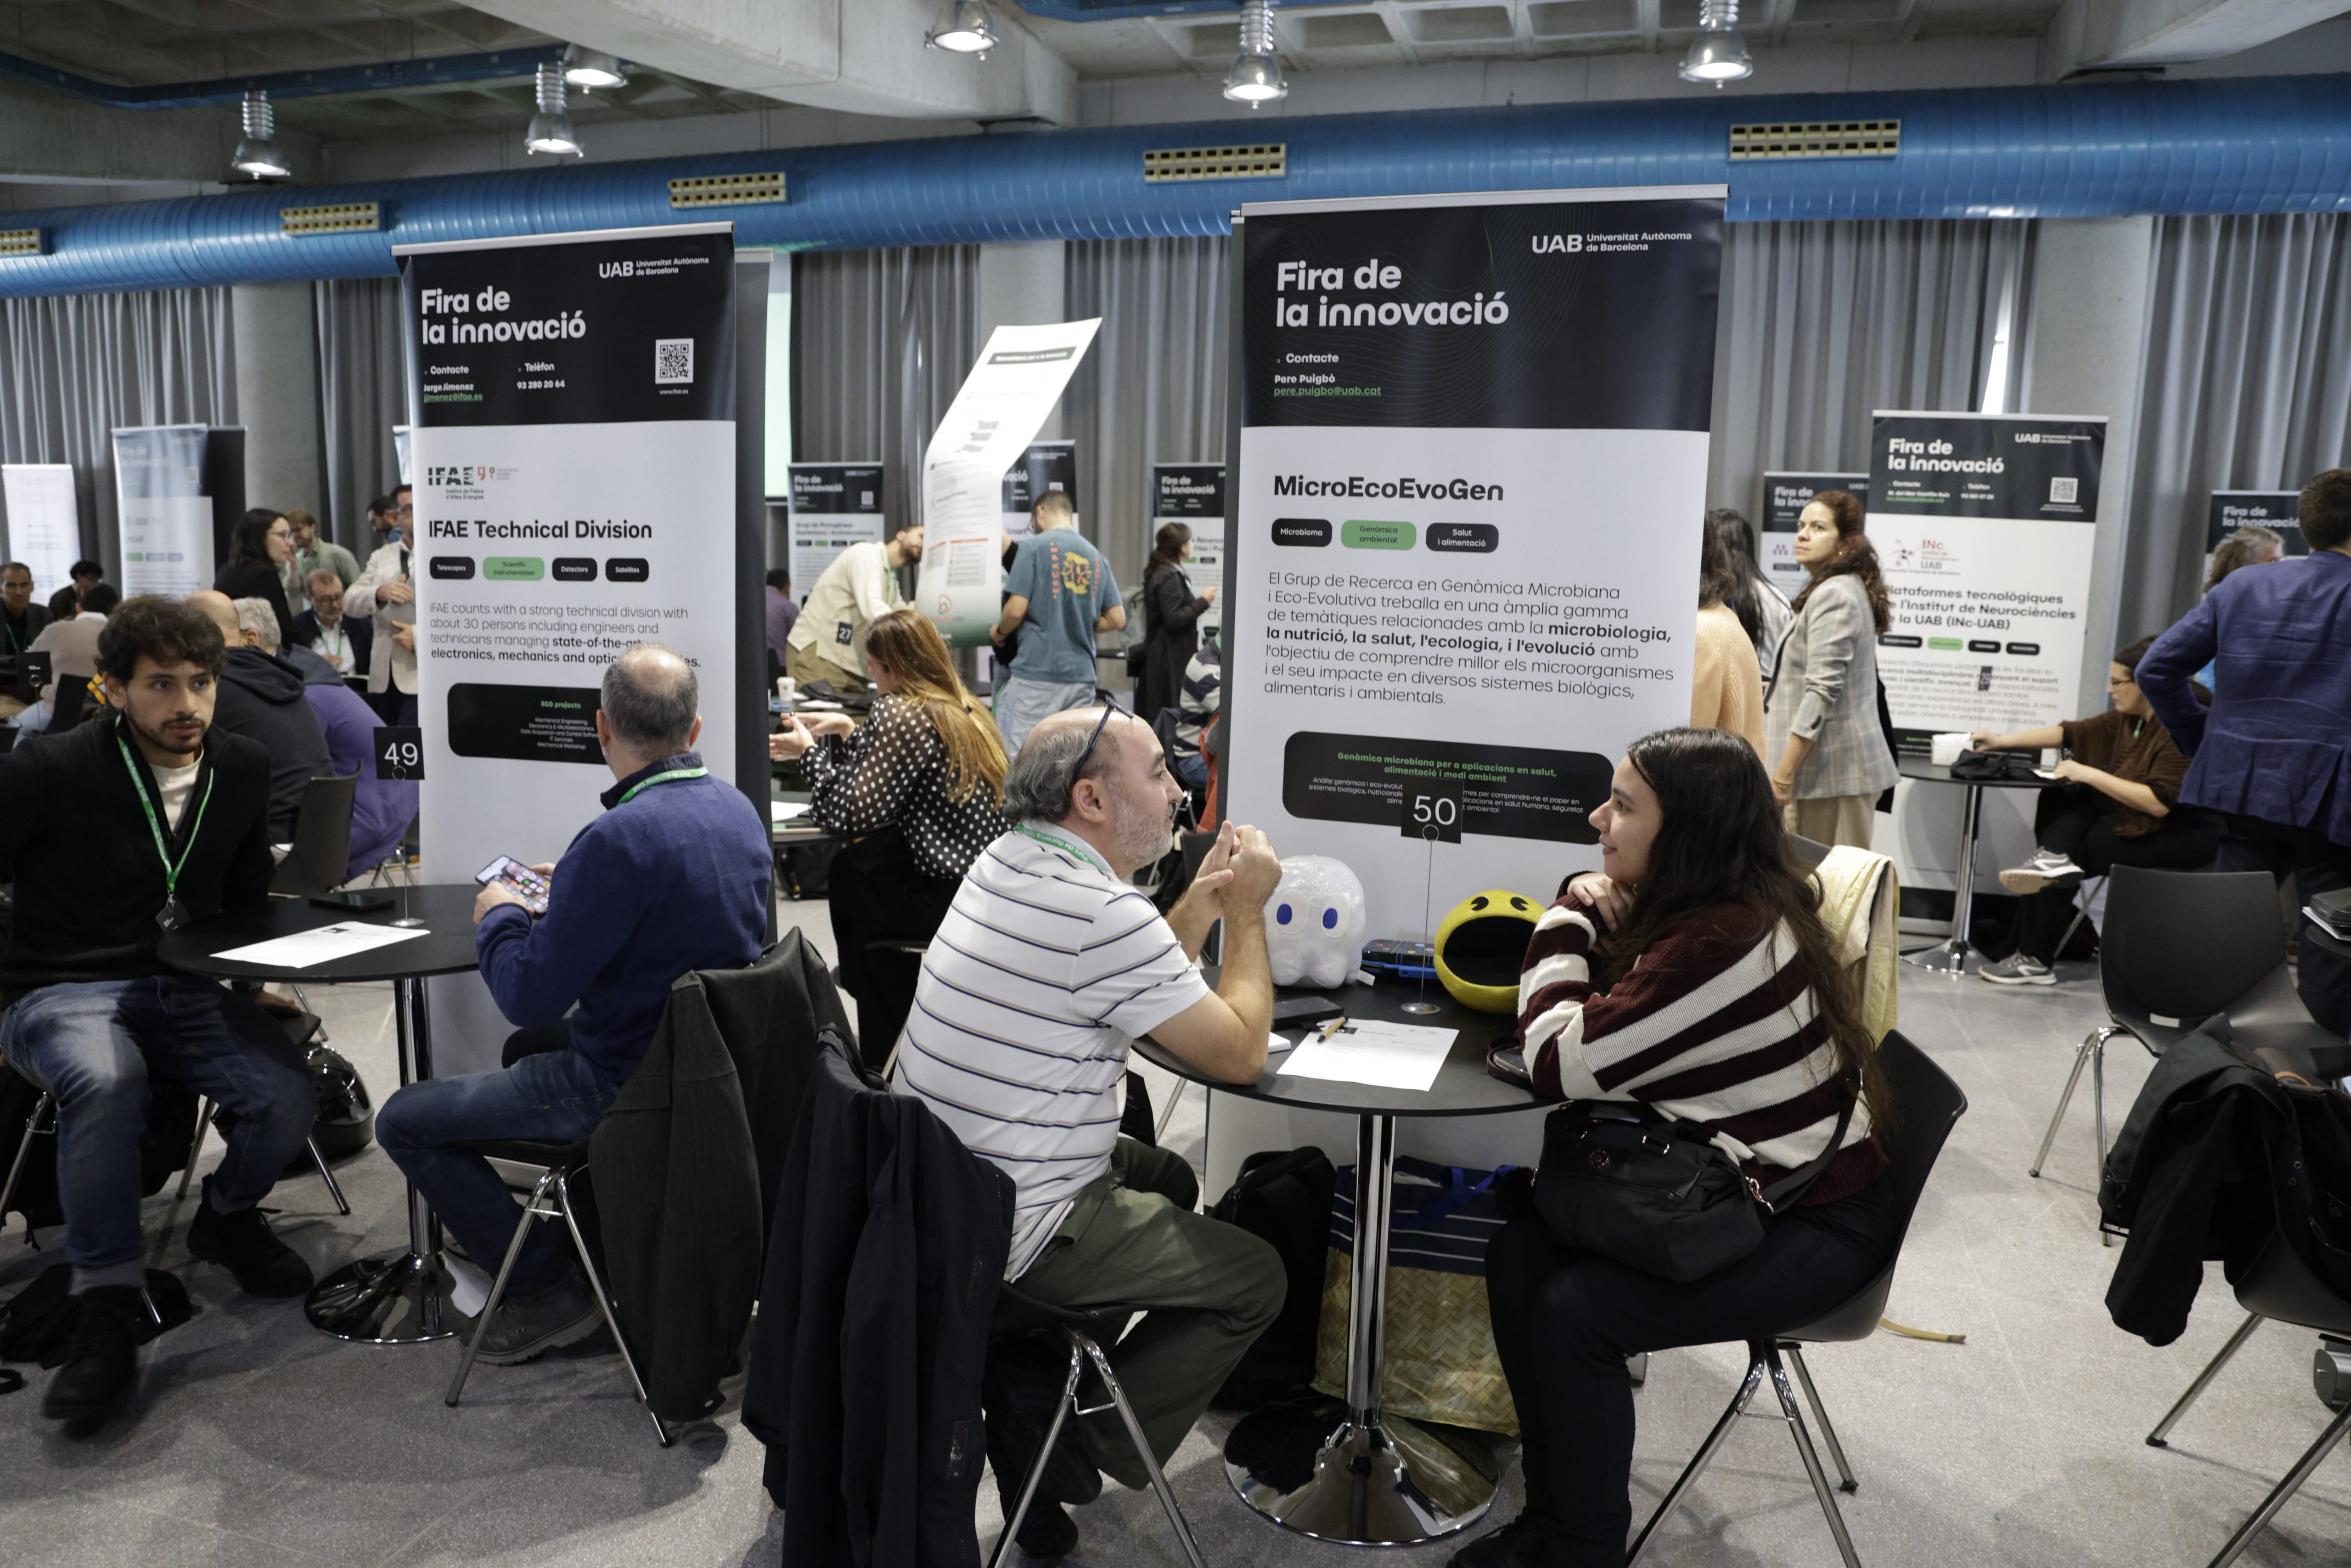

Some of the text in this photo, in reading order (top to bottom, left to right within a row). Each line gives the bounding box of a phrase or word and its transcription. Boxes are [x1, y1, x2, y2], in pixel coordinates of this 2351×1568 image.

[1532, 234, 1583, 254] UAB
[1586, 232, 1692, 242] Universitat Autònoma
[1586, 242, 1649, 252] de Barcelona
[599, 261, 634, 279] UAB
[636, 257, 709, 267] Universitat Autònoma
[636, 267, 679, 276] de Barcelona
[1277, 258, 1402, 291] Fira de
[421, 286, 511, 315] Fira de
[1276, 291, 1509, 327] la innovació
[422, 310, 587, 345] la innovació
[1285, 353, 1339, 364] Contacte
[430, 365, 469, 375] Contacte
[524, 362, 555, 372] Telèfon
[423, 382, 474, 393] Jorge Jimenez
[516, 381, 527, 390] 93
[543, 380, 554, 389] 20
[555, 379, 565, 388] 64
[1274, 373, 1336, 386] Pere Puigbò
[1273, 386, 1382, 397] pere.puigbo@uab.cat
[1889, 437, 1953, 455] Fira de
[2015, 433, 2041, 444] UAB
[1888, 455, 2005, 474] la innovació
[428, 466, 474, 486] IFAE
[1273, 475, 1504, 501] MicroEcoEvoGen
[2223, 506, 2268, 517] Fira de
[429, 519, 652, 539] IFAE Technical Division
[1359, 525, 1398, 534] Genòmica
[2222, 517, 2235, 527] la
[1280, 527, 1323, 537] Microbioma
[1359, 535, 1398, 544] ambiental
[1452, 528, 1472, 537] Salut
[1441, 538, 1486, 548] alimentació
[560, 566, 589, 574] Detectors
[1269, 572, 1620, 600] El Grup de Recerca en Genòmica Microbiana
[1275, 590, 1377, 607] Eco-Evolutiva
[1381, 595, 1439, 610] treballa
[1444, 600, 1464, 612] en
[1468, 601, 1499, 613] una
[1503, 599, 1559, 617] àmplia
[1563, 606, 1629, 620] gamma
[1967, 590, 2064, 604] tecnològiques
[429, 602, 688, 619] IFAE counts with a strong technical division with
[1959, 604, 1975, 614] de
[1979, 605, 2076, 619] Neurociències
[430, 618, 659, 635] about 30 persons including engineers and
[1267, 608, 1672, 643] de temàtiques relacionades amb la microbiologia,
[1899, 613, 2011, 630] la UAB (INc-UAB)
[430, 633, 492, 645] technicians
[494, 635, 550, 649] managing
[839, 628, 852, 640] 27
[1266, 626, 1280, 640] la
[1284, 628, 1348, 644] nutrició,
[1352, 630, 1367, 644] la
[1371, 632, 1416, 648] salut,
[1420, 634, 1503, 653] l'ecologia,
[1516, 639, 1596, 656] l'evolució
[1600, 645, 1639, 659] amb
[431, 648, 496, 661] electronics,
[498, 650, 560, 662] mechanics
[562, 652, 585, 663] and
[1266, 644, 1674, 681] l'objectiu de comprendre millor els microorganismes
[1271, 663, 1284, 676] el
[1288, 666, 1315, 678] seu
[1319, 666, 1383, 682] impacte
[1387, 672, 1407, 684] en
[1411, 671, 1477, 688] diversos
[1481, 676, 1553, 692] sistemes
[1557, 679, 1635, 700] biològics,
[1264, 680, 1345, 698] alimentaris
[1357, 687, 1446, 705] ambientals.
[384, 742, 419, 766] 49
[1337, 752, 1382, 763] Genòmica
[1384, 755, 1434, 767] microbiana
[1436, 760, 1451, 770] per
[1462, 762, 1515, 774] aplicacions
[1531, 767, 1557, 777] salut,
[1384, 766, 1437, 777] alimentació
[1443, 770, 1467, 779] medi
[1468, 772, 1507, 783] ambient
[1549, 797, 1570, 805] paper
[1413, 795, 1457, 825] 50
